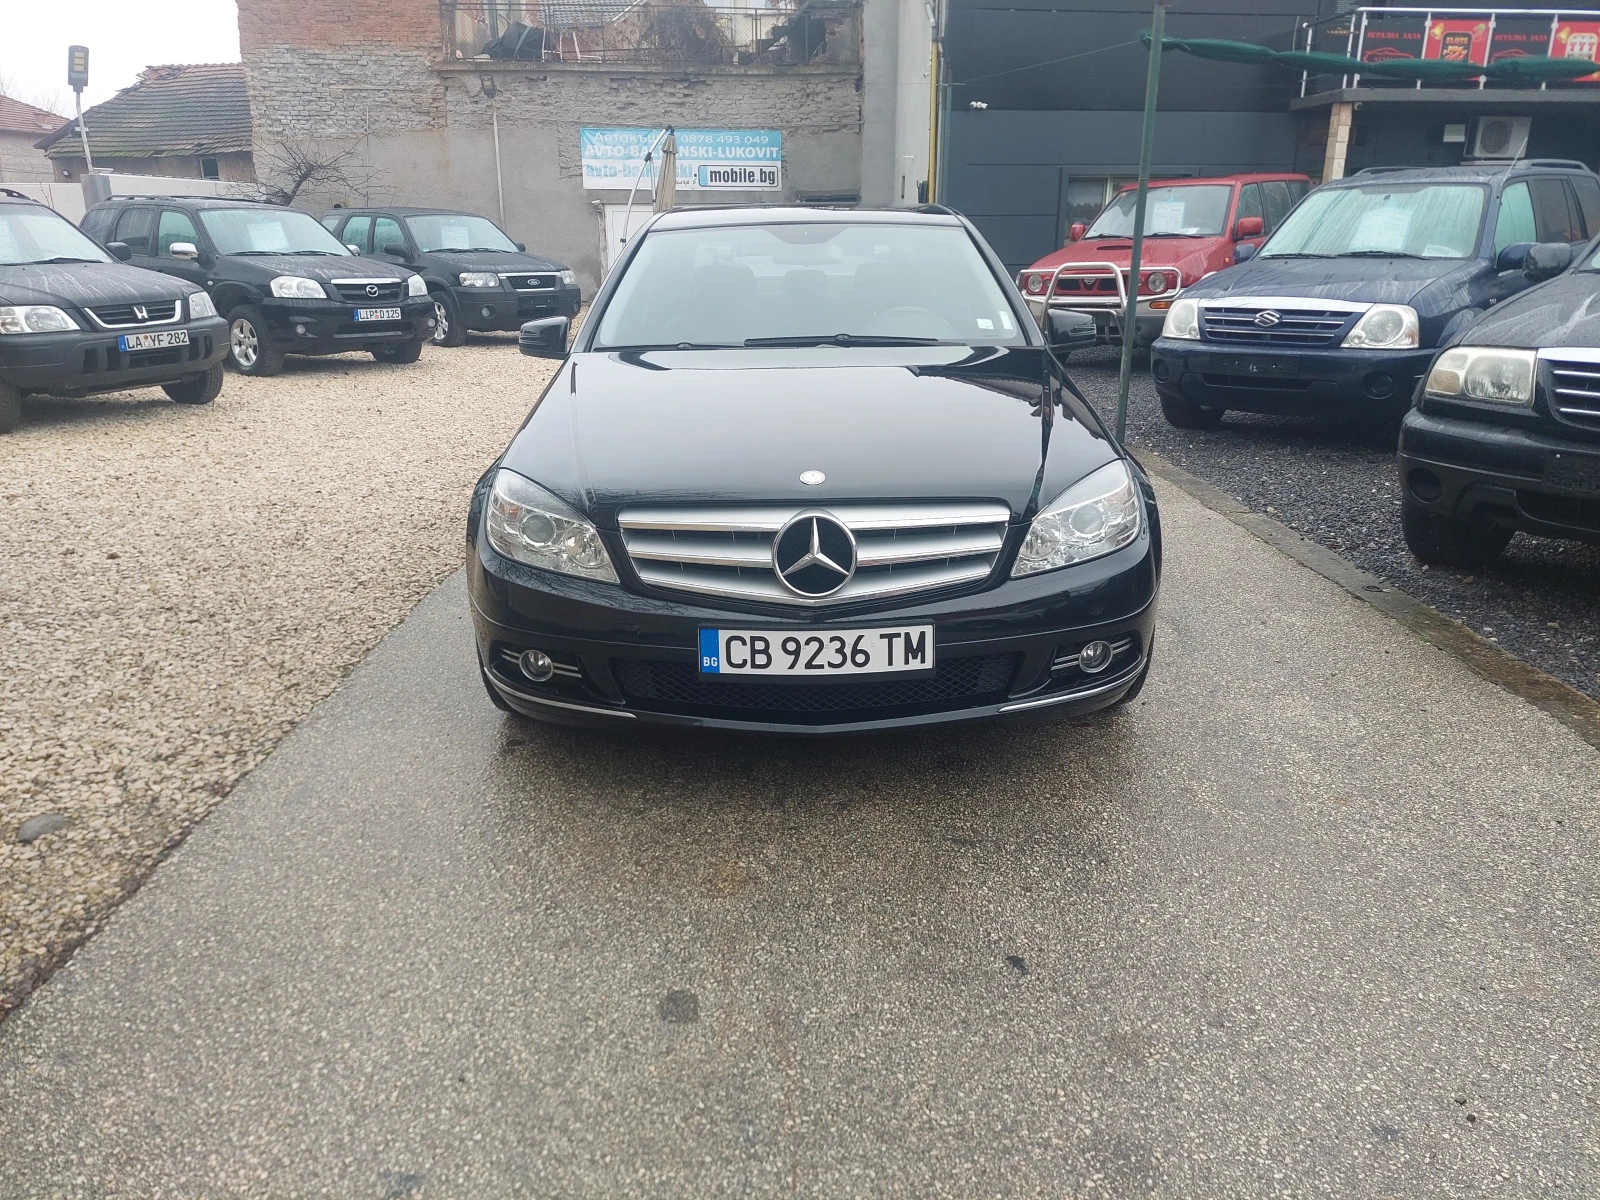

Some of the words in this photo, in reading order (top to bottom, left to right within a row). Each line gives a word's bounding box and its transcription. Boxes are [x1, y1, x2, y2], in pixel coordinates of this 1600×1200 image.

[1569, 41, 1595, 52] 777
[680, 134, 713, 143] 0878
[716, 135, 741, 144] 493
[744, 135, 769, 144] 049
[709, 167, 775, 185] mobile.bg
[359, 310, 375, 320] LIP
[126, 336, 143, 349] LA
[149, 334, 164, 347] YF
[166, 331, 188, 345] 282
[725, 635, 773, 669] CB
[781, 634, 871, 670] 9236
[879, 630, 926, 666] TM
[703, 657, 718, 667] BG
